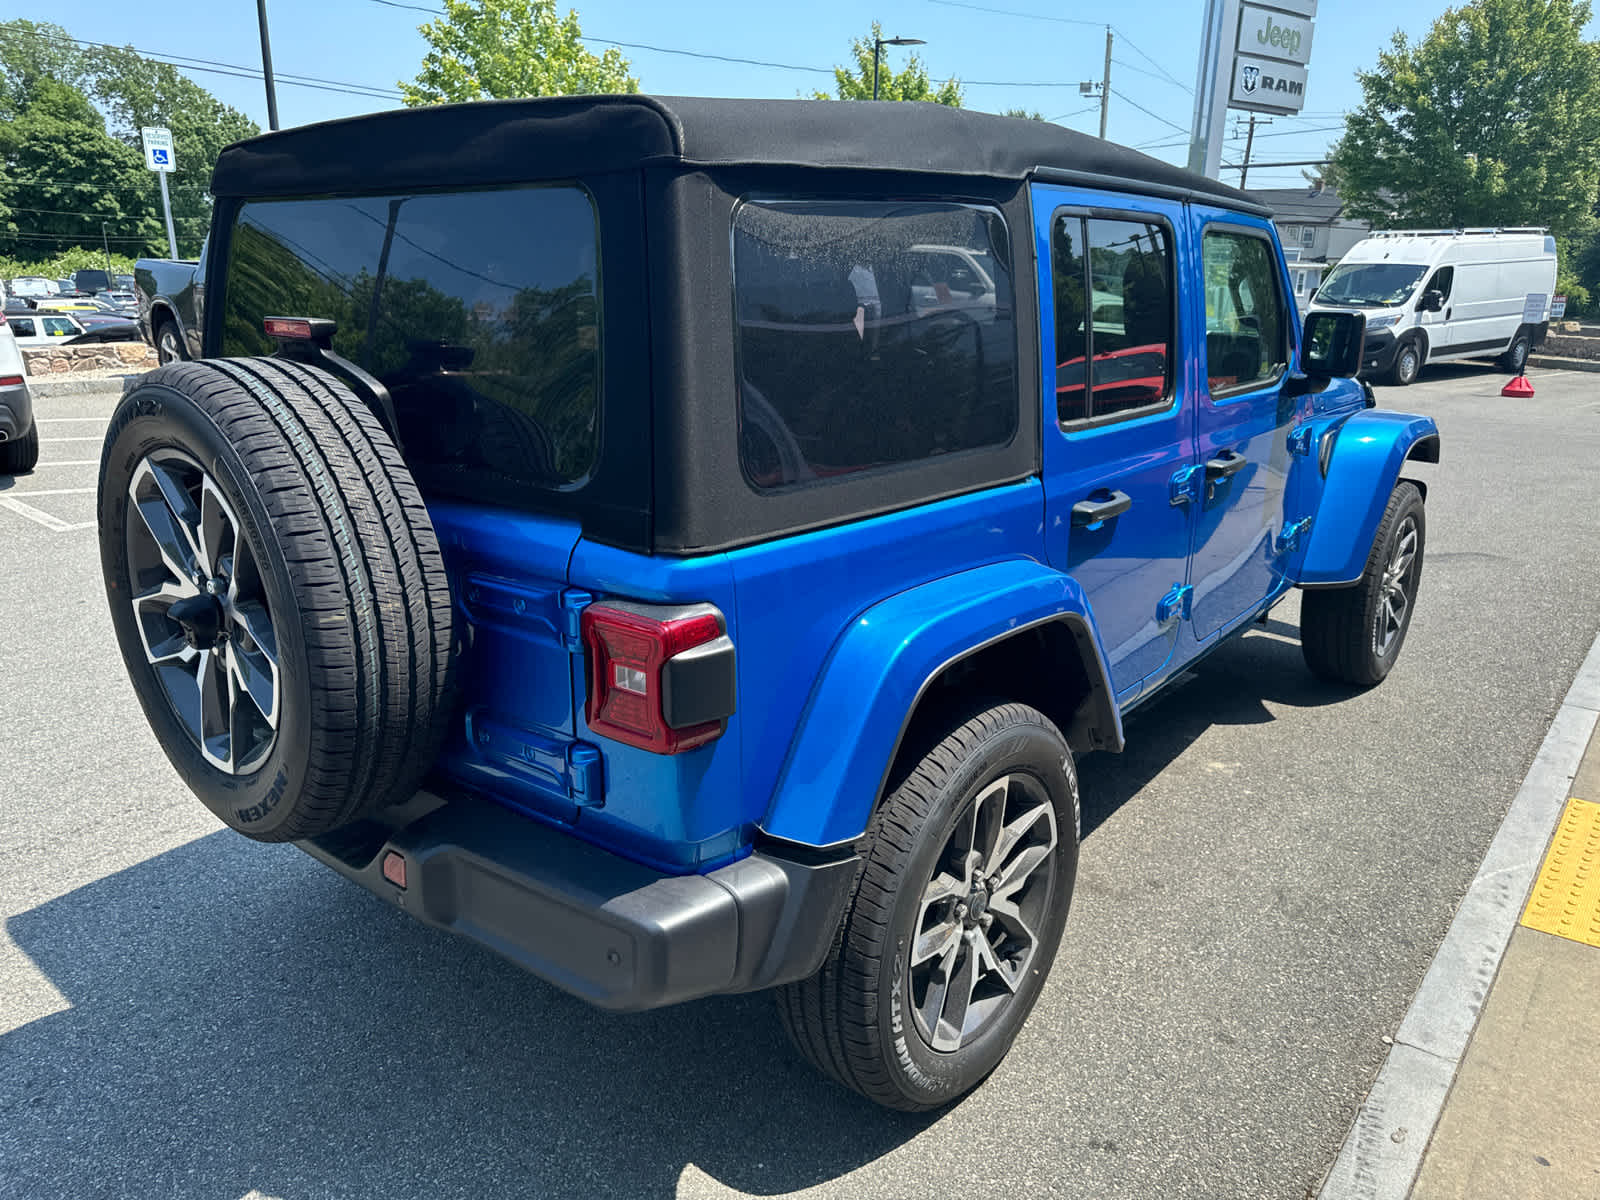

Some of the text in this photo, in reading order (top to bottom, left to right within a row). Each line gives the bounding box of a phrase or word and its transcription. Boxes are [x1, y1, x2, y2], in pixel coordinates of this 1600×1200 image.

[1257, 16, 1301, 56] Jeep
[1261, 75, 1304, 96] RAM
[237, 769, 289, 823] NEXEN
